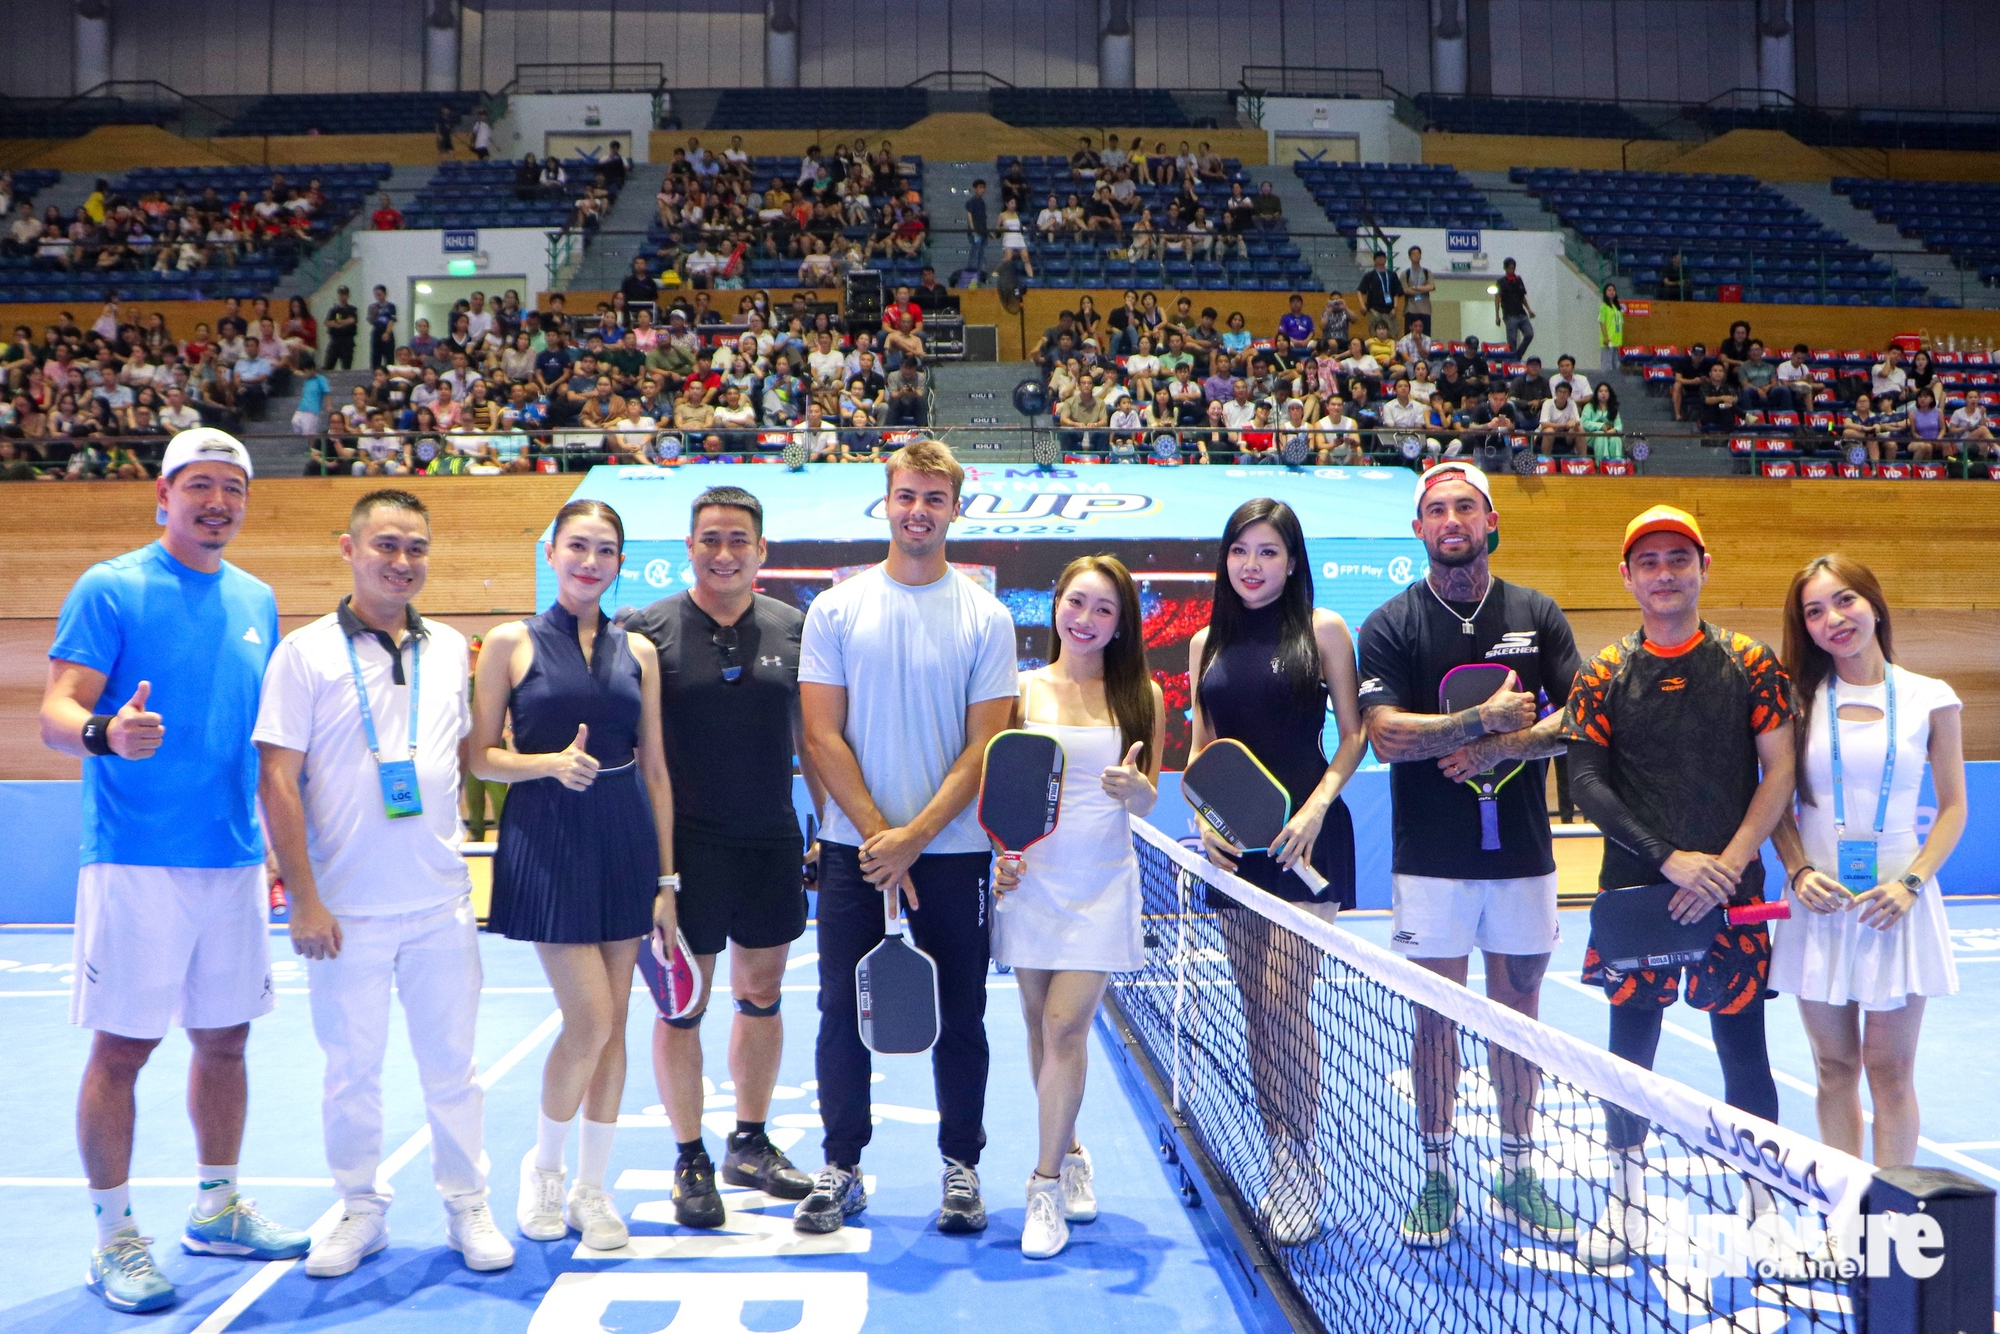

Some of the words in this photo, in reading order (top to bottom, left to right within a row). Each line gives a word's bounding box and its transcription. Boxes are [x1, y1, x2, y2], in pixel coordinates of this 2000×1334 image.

[445, 236, 465, 246] KHU
[467, 236, 475, 246] B
[1450, 235, 1470, 247] KHU
[1472, 235, 1478, 247] B
[1623, 348, 1639, 356] VIP
[1654, 348, 1670, 356] VIP
[1844, 352, 1860, 360] VIP
[1937, 355, 1952, 363] VIP
[1967, 356, 1983, 364] VIP
[1508, 367, 1525, 376] VIP
[1648, 370, 1665, 378] VIP
[1812, 371, 1829, 381] VIP
[1940, 375, 1955, 383] VIP
[1971, 377, 1987, 385] VIP
[1774, 417, 1792, 425] VIP
[1810, 418, 1828, 427] VIP
[765, 434, 785, 443] VIP
[891, 433, 911, 443] VIP
[1767, 441, 1786, 450] VIP
[1004, 468, 1079, 479] MB
[1566, 464, 1587, 474] VIP
[1606, 466, 1626, 475] VIP
[1768, 468, 1787, 477] VIP
[1807, 469, 1826, 477] VIP
[1883, 469, 1902, 478] VIP
[1919, 470, 1937, 478] VIP
[961, 525, 1076, 535] 2025
[1340, 565, 1360, 576] FPT
[1362, 565, 1383, 578] Play
[1050, 782, 1059, 800] JOOLA
[391, 791, 412, 801] LOC
[1206, 811, 1221, 828] JOOLA
[1650, 955, 1668, 965] JOOLA
[1724, 1123, 1831, 1204] JOOLA
